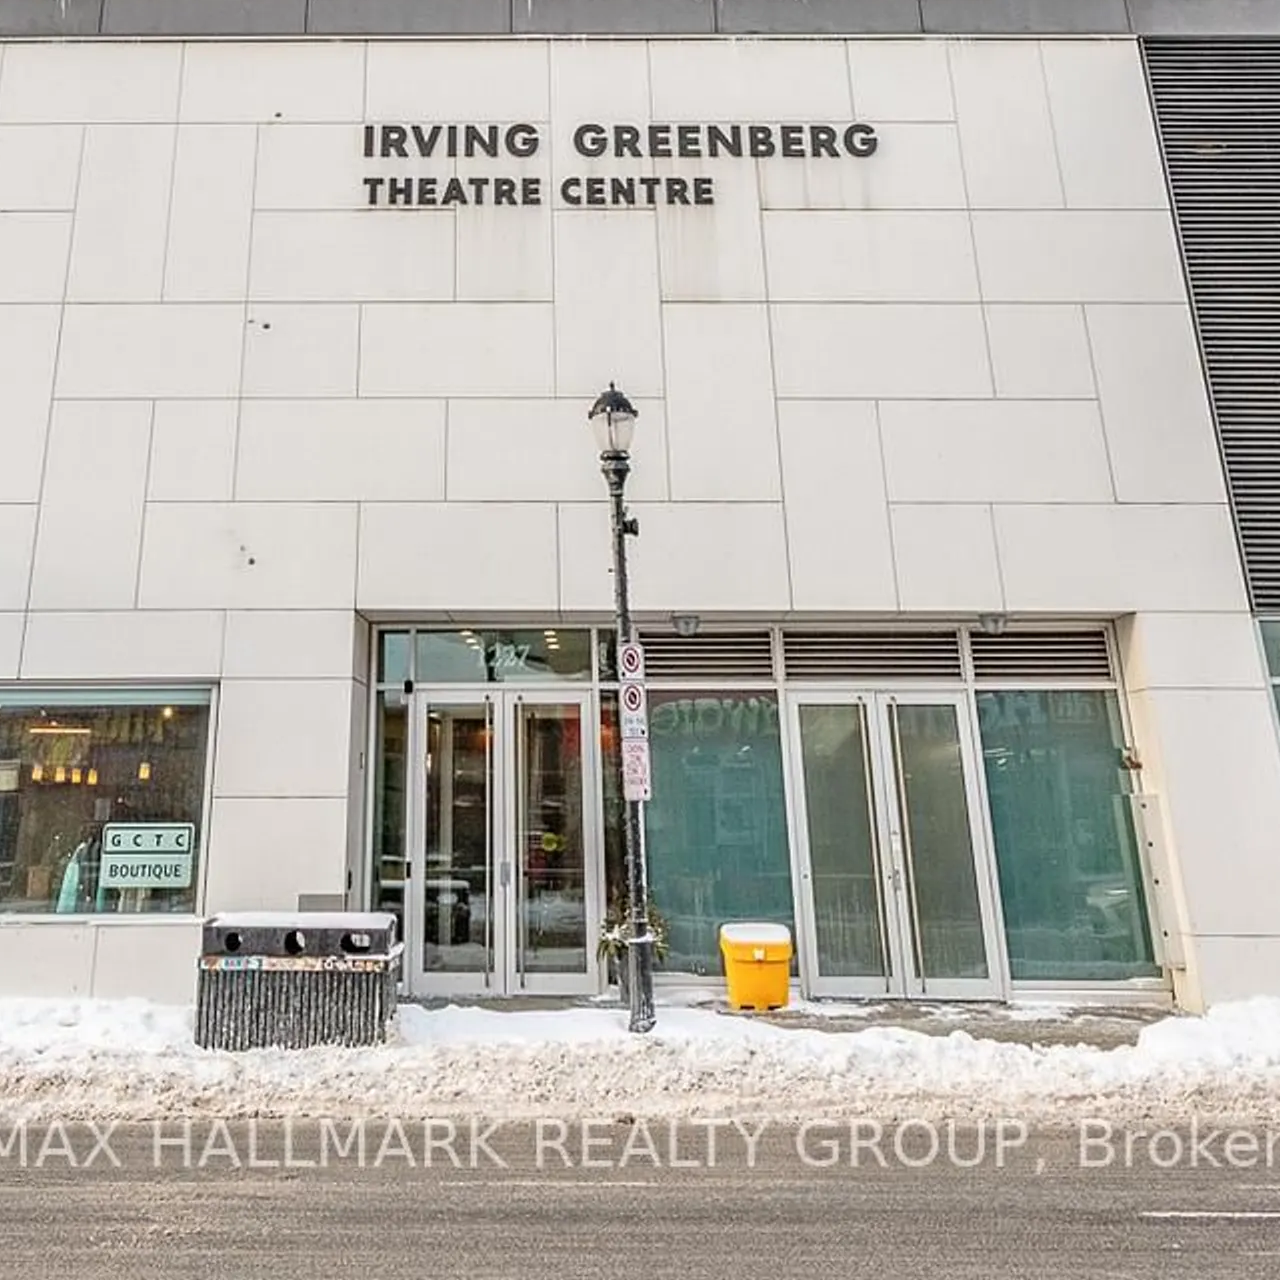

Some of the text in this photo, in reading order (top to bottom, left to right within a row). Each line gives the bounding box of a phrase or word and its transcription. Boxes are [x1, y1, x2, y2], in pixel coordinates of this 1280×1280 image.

[363, 124, 879, 158] IRVING GREENBERG
[363, 177, 715, 205] THEATRE CENTRE
[109, 864, 183, 880] BOUTIQUE
